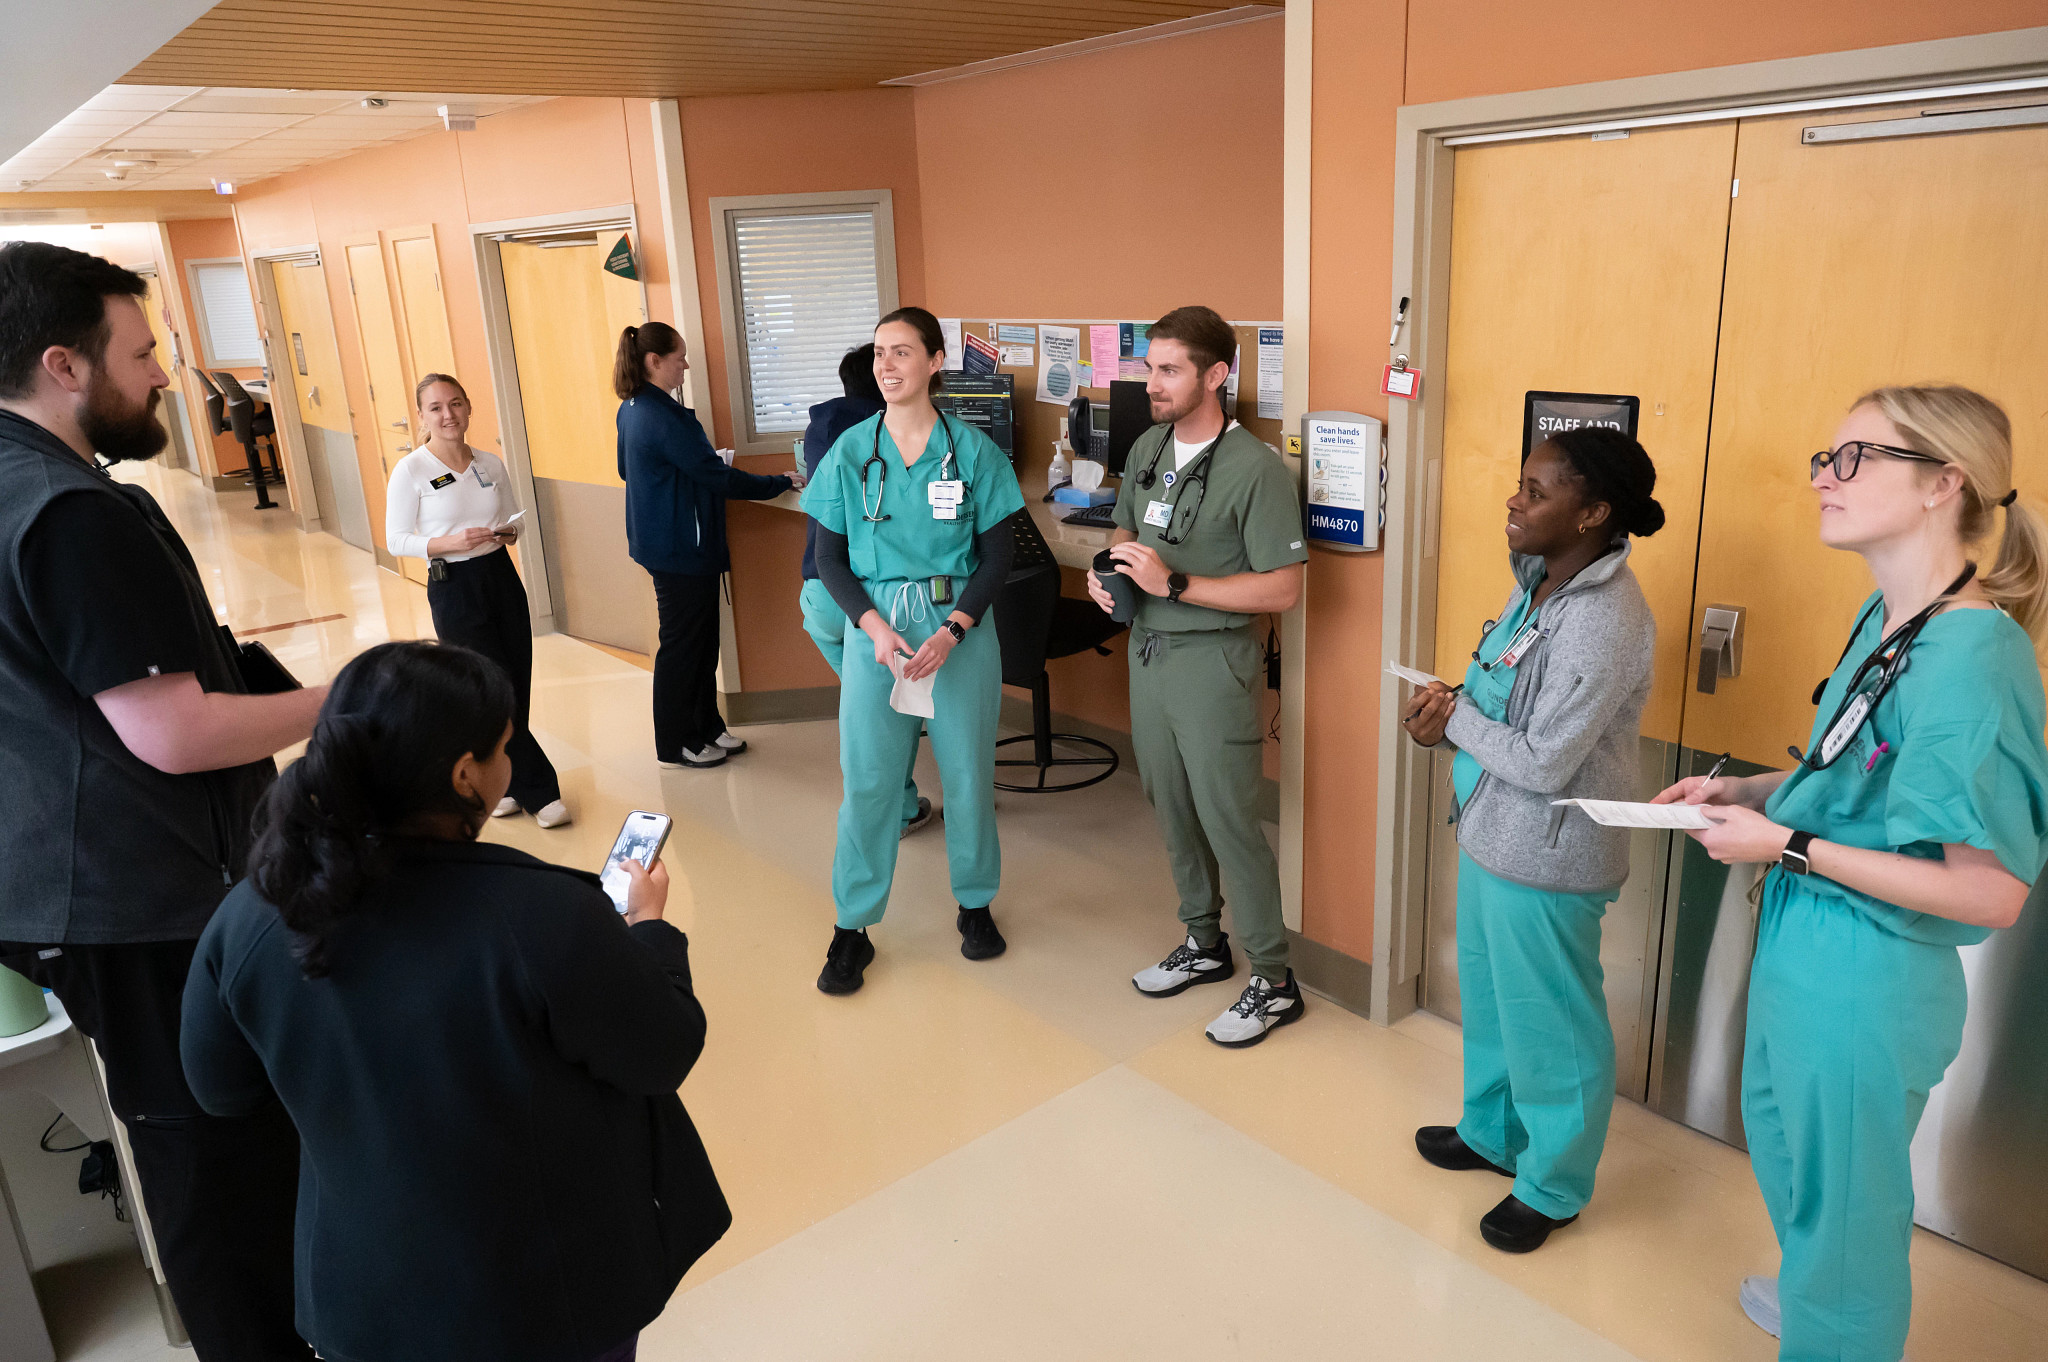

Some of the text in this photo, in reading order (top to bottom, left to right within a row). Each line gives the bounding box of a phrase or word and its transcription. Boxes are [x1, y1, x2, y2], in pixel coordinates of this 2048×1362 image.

[1316, 425, 1360, 436] Clean hands
[1538, 416, 1621, 432] STAFF AND
[1320, 436, 1356, 445] save lives.
[1311, 514, 1359, 533] HM4870
[1487, 688, 1509, 707] GUNDE
